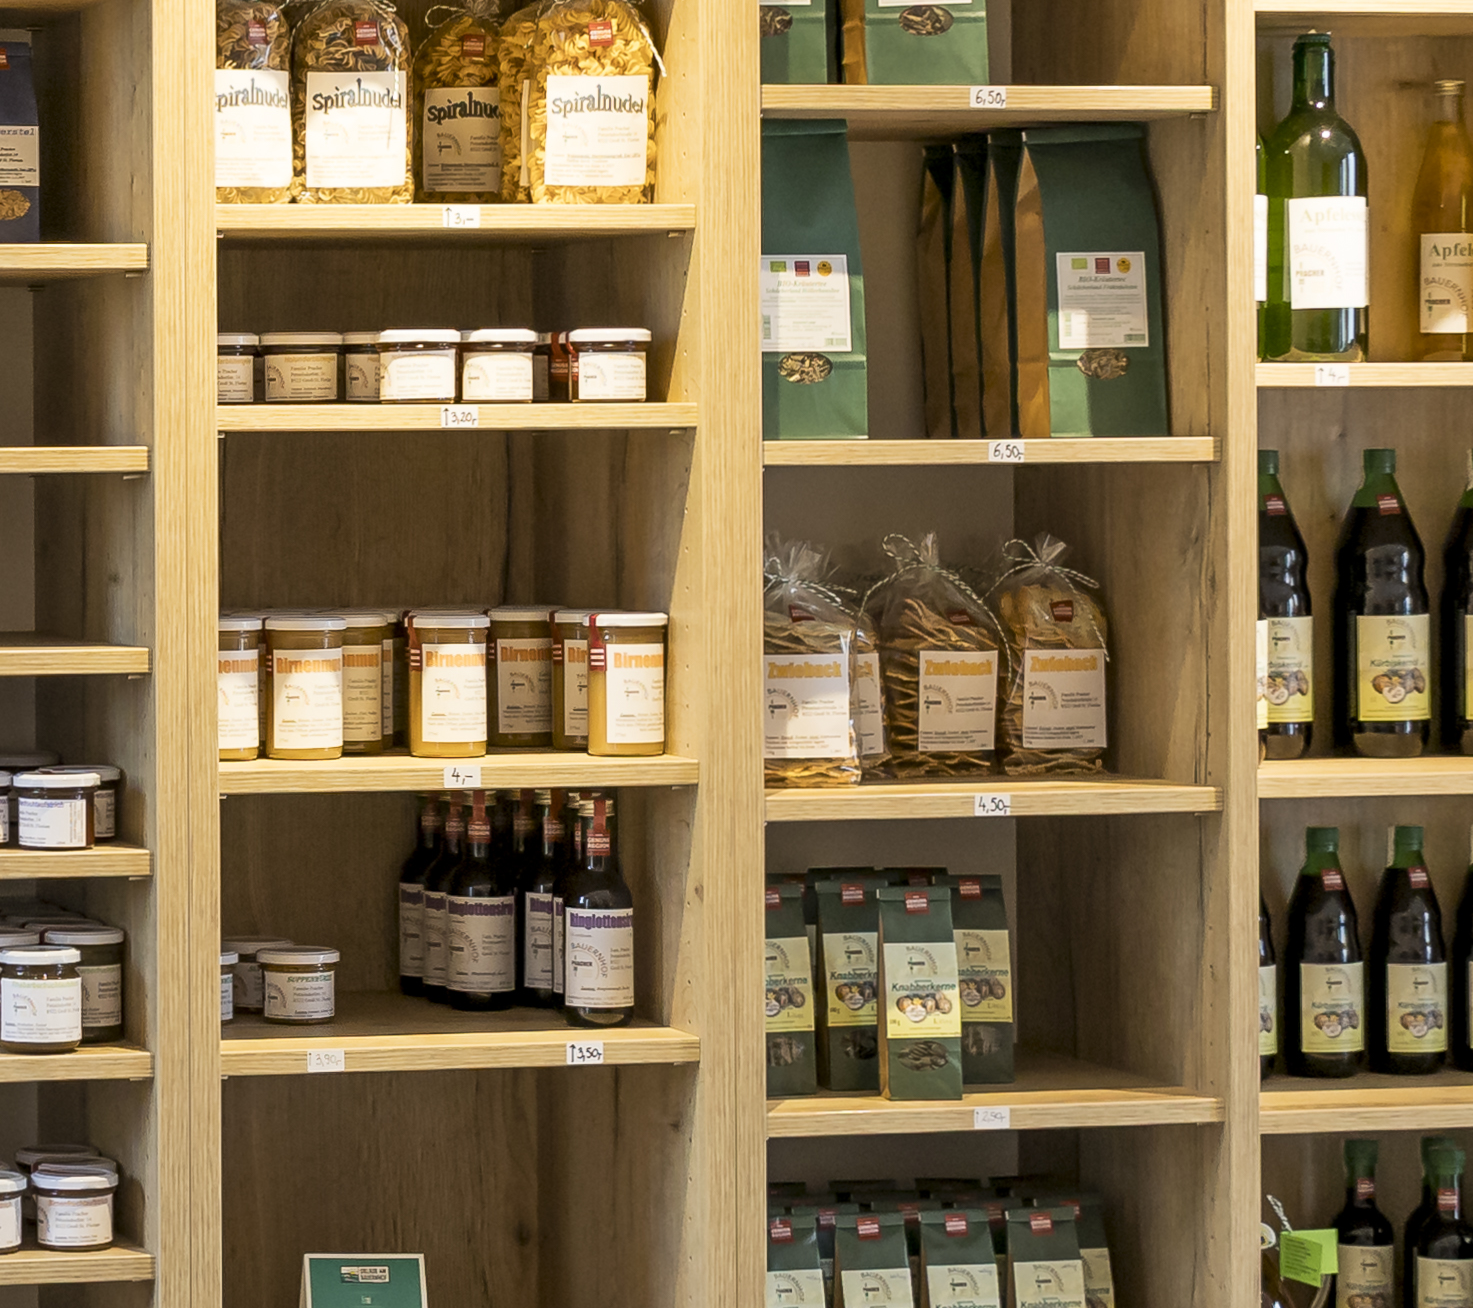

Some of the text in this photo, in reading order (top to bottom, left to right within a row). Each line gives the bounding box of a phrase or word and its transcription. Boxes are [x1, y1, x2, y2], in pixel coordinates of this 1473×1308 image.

[216, 77, 289, 112] piralnudel
[313, 78, 403, 115] Spiralnudel
[427, 91, 501, 126] Spiralnu
[552, 84, 644, 118] Spiralnudel
[891, 980, 957, 994] Knabberkerne
